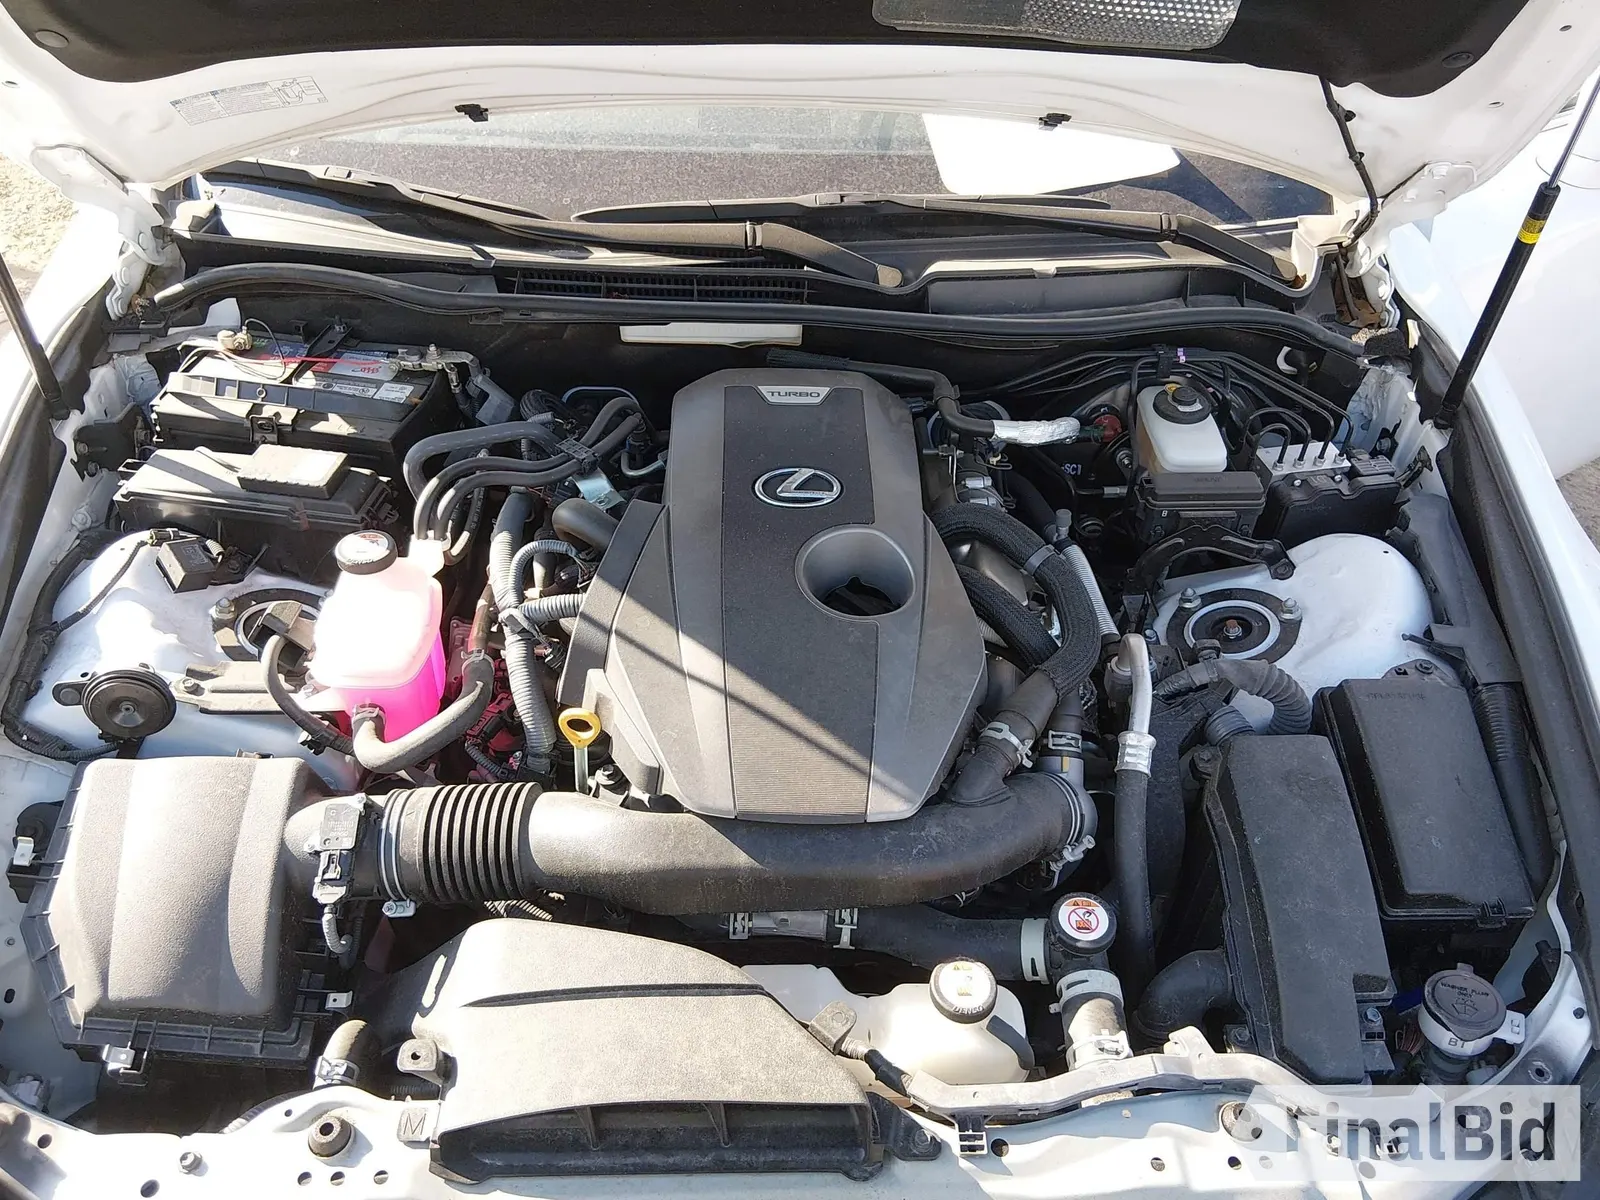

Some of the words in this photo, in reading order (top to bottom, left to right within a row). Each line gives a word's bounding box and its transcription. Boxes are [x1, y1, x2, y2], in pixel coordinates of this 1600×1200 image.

[766, 390, 821, 398] TURBO
[953, 1005, 986, 1015] DENSO
[403, 1112, 427, 1136] M
